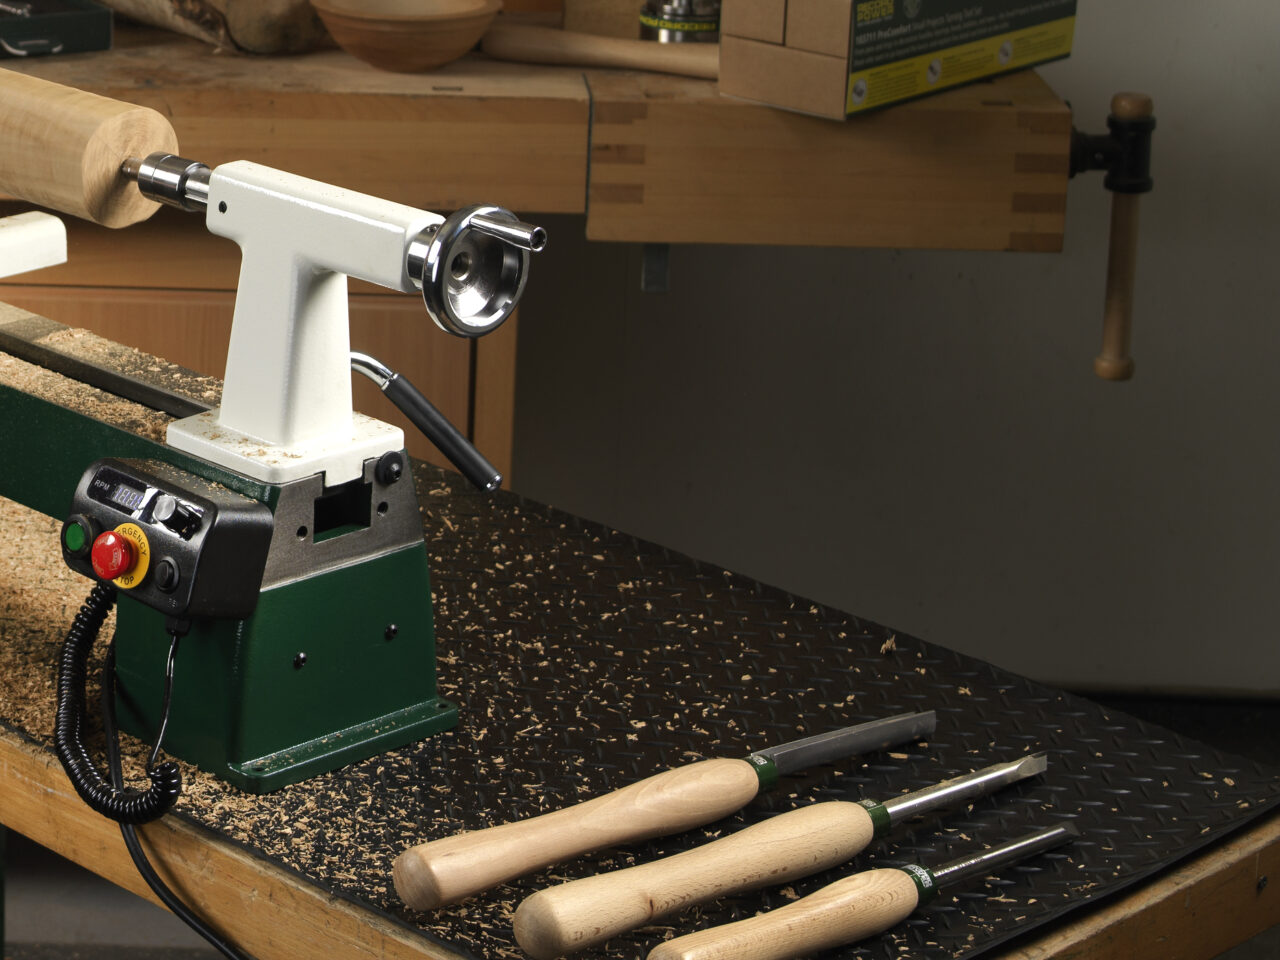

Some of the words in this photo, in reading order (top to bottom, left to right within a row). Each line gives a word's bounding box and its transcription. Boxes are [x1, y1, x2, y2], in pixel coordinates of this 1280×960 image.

[856, 4, 894, 22] POWER
[94, 479, 110, 490] RPM
[117, 527, 147, 557] RGENCY
[116, 575, 134, 585] TOP
